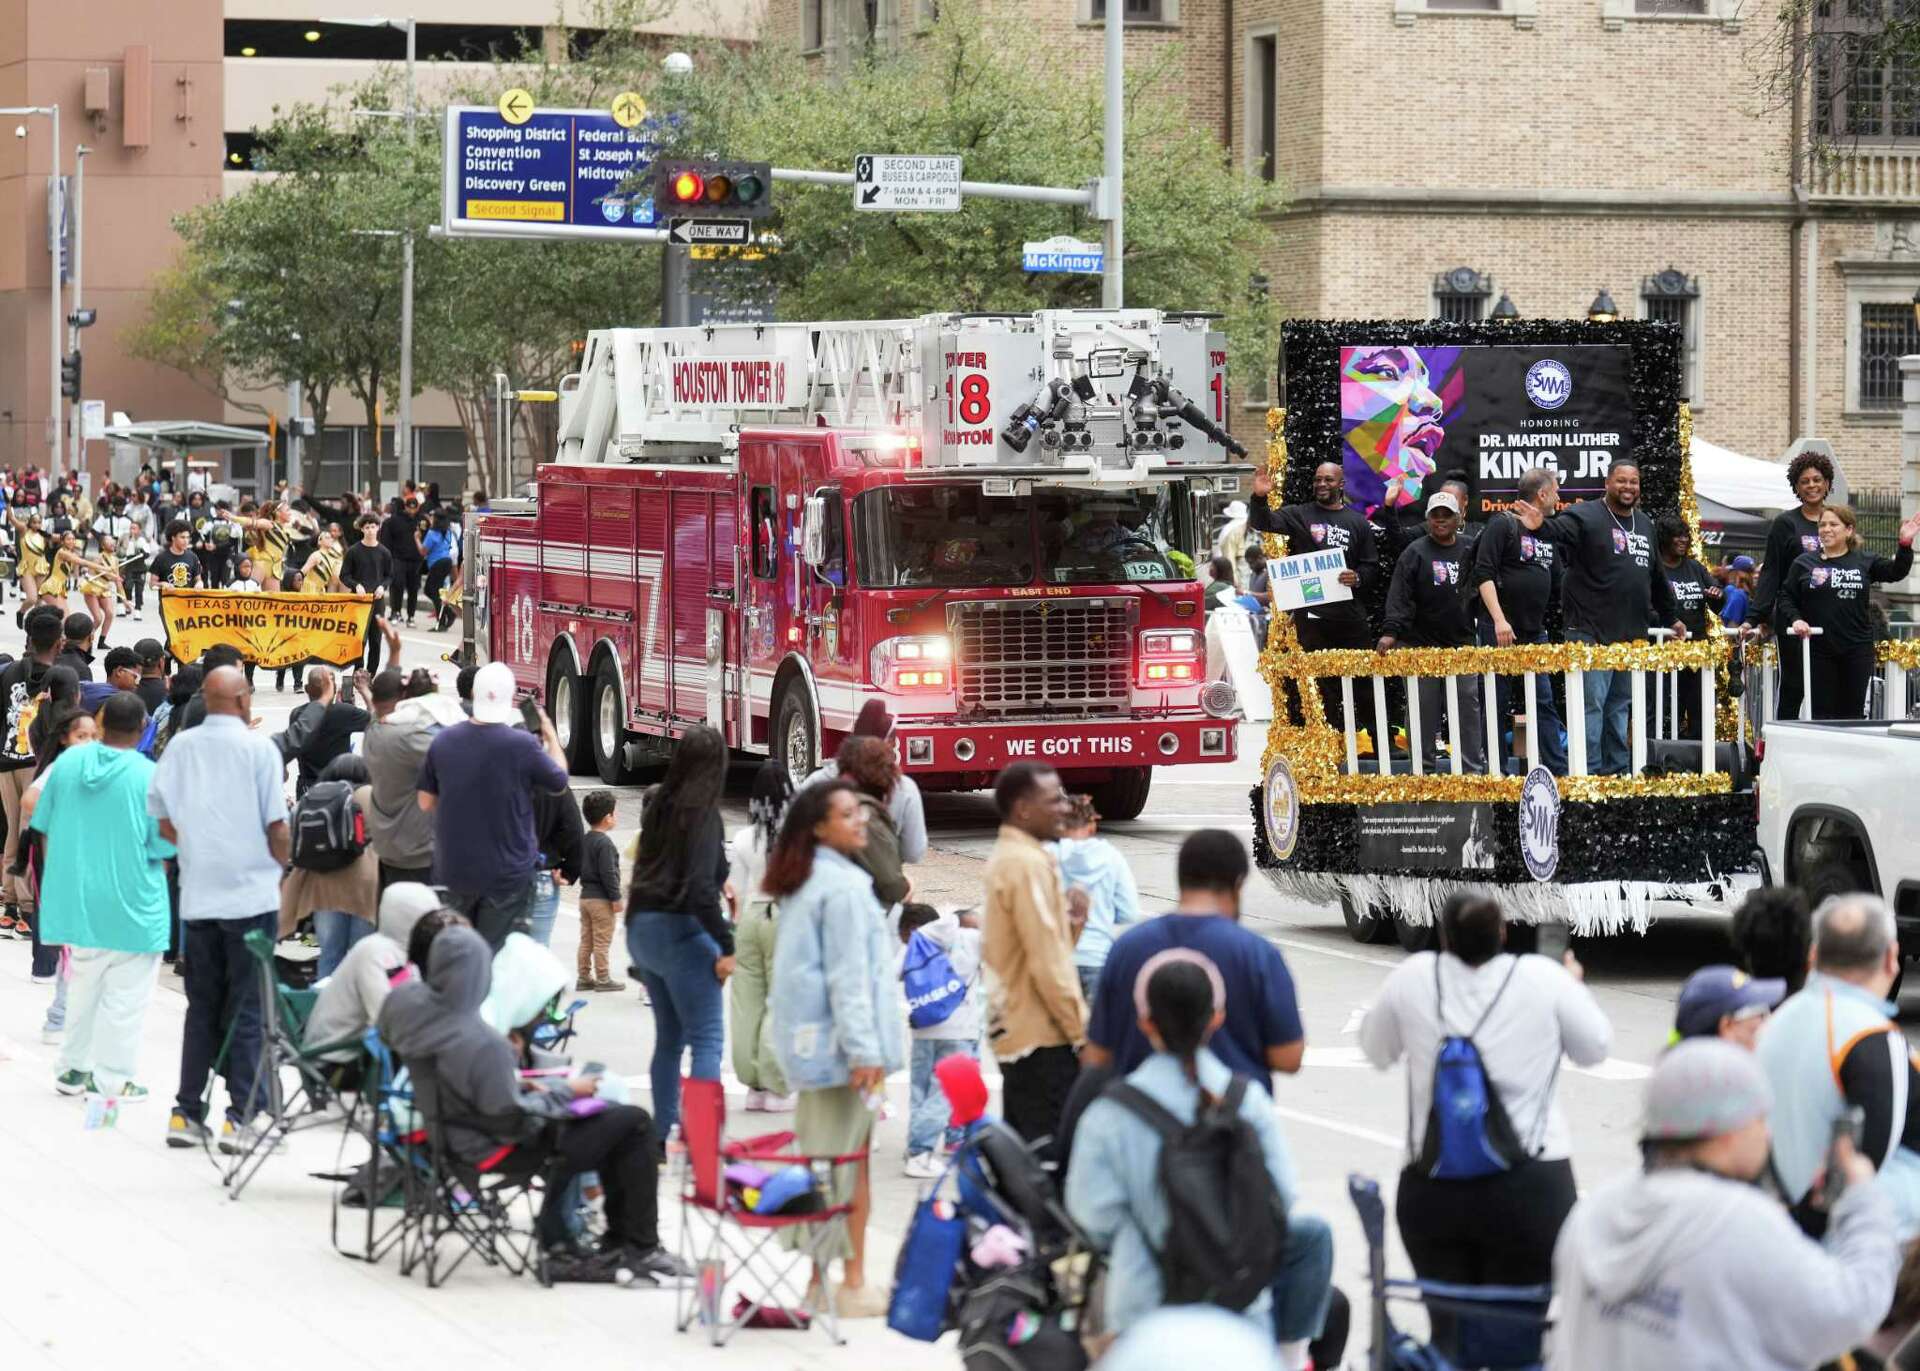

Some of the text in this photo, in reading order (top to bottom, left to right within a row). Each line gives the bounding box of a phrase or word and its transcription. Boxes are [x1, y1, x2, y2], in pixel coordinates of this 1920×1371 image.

[466, 126, 567, 142] Shopping District
[578, 129, 623, 142] Federal
[466, 146, 541, 160] Convention
[578, 148, 590, 161] St
[593, 149, 633, 163] Joseph
[465, 158, 514, 172] District
[884, 159, 956, 171] SECOND LANE
[578, 167, 634, 181] Midtown
[882, 171, 908, 182] BUSES
[915, 172, 958, 182] CARPOOLS
[465, 176, 567, 193] Discovery Green
[883, 187, 915, 195] 7-9AM
[894, 197, 918, 205] MON
[929, 197, 945, 206] FRI
[474, 204, 556, 218] Second Signal
[688, 226, 740, 237] ONE WAY
[1025, 254, 1100, 271] McKinney
[673, 360, 785, 405] HOUSTON TOWER 18
[1534, 373, 1564, 394] SWM
[946, 373, 991, 425] 18
[1520, 419, 1580, 428] HONORING
[1479, 433, 1620, 447] DR. MARTIN LUTHER
[1479, 451, 1568, 484] KING,
[1131, 564, 1161, 576] 19A
[1270, 552, 1344, 580] I AM A MAN
[1831, 567, 1861, 576] Driven
[1011, 586, 1072, 597] EAST END
[1831, 580, 1863, 590] Dream
[186, 599, 348, 614] TEXAS YOUTH ACADEMY
[174, 613, 359, 637] MARCHING THUNDER
[511, 593, 534, 665] 18
[278, 648, 311, 664] TEXAS
[1006, 736, 1133, 756] WE GOT THIS
